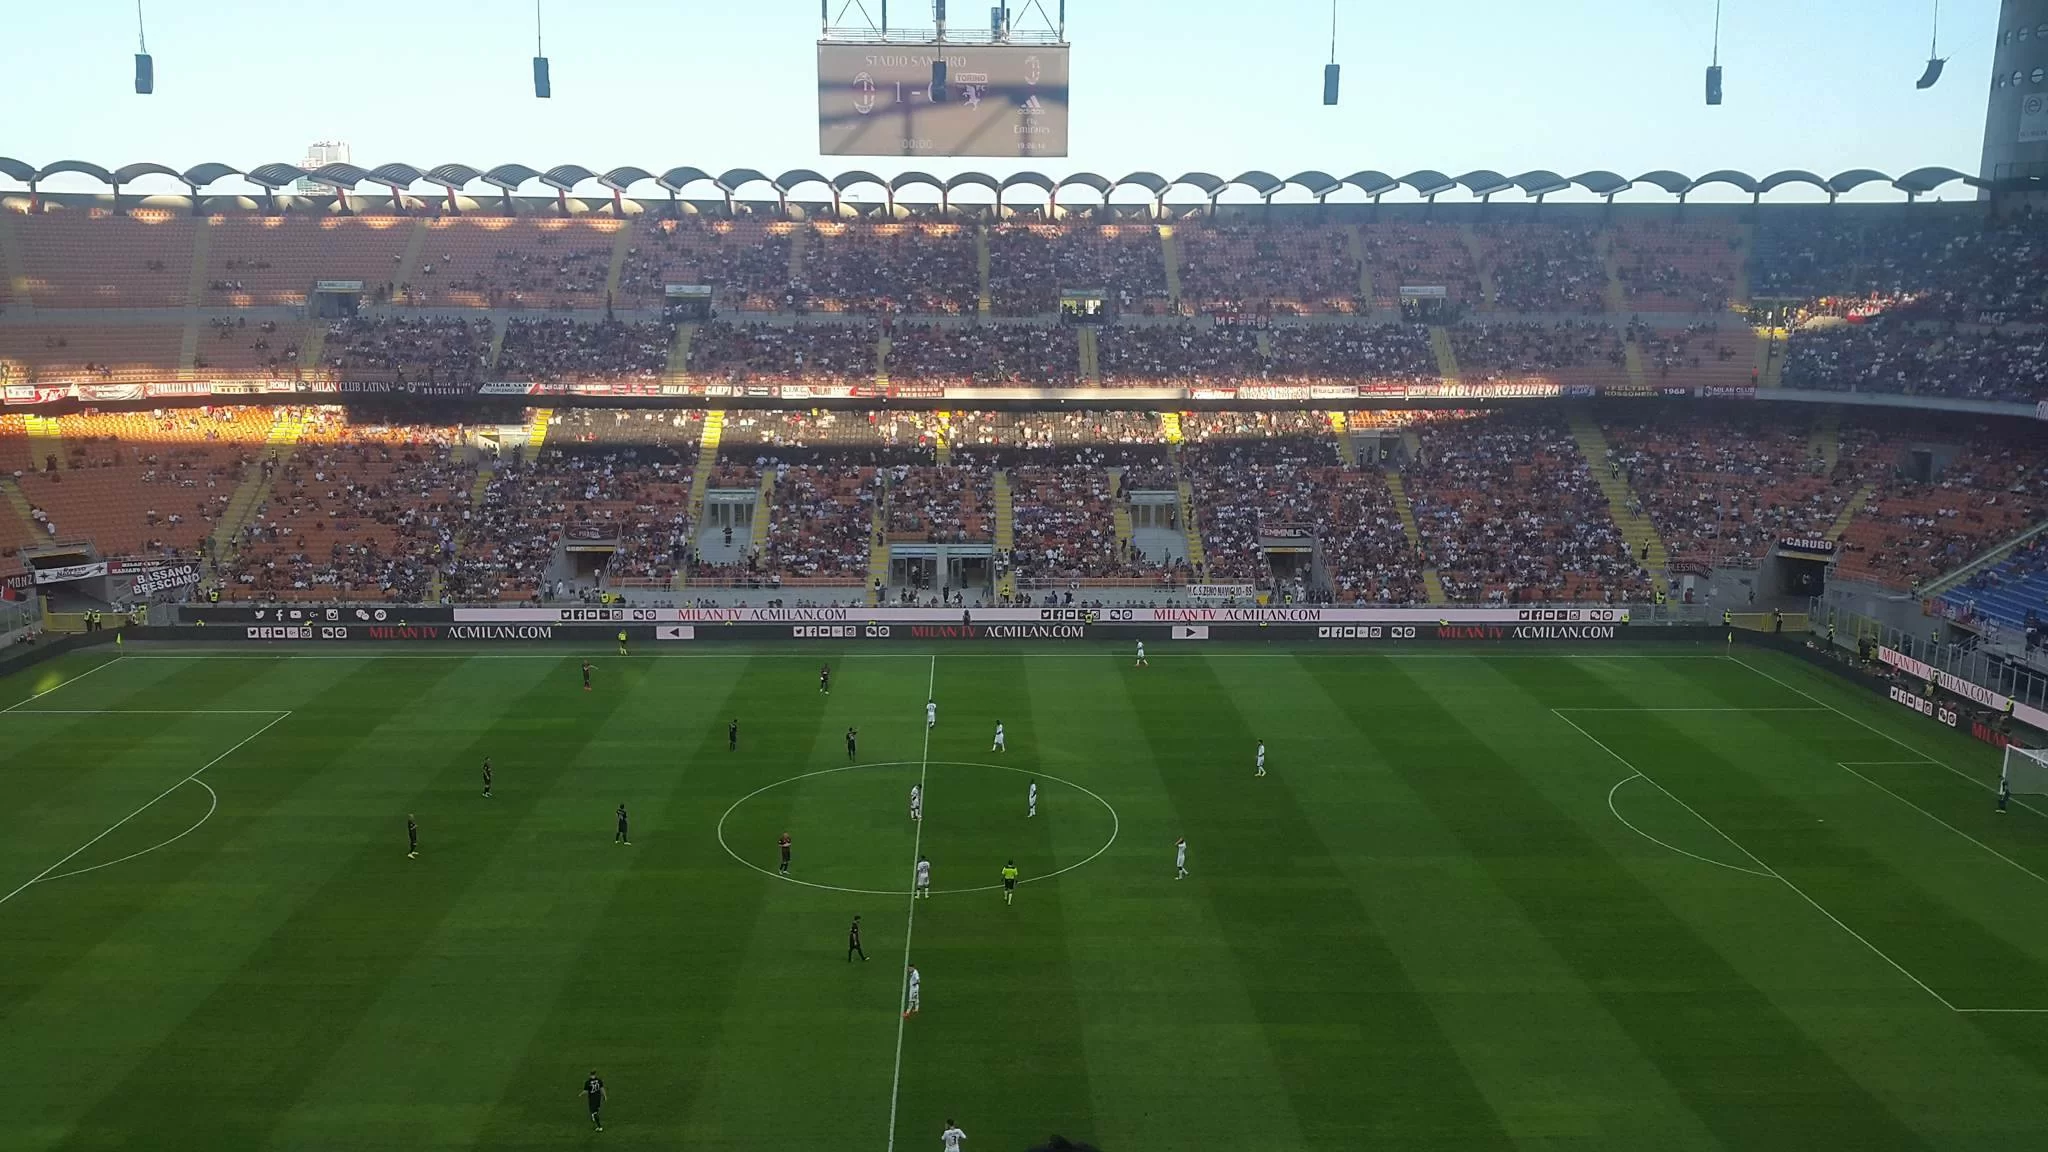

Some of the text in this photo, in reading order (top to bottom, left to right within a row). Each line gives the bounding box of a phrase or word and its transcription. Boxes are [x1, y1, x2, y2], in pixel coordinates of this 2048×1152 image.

[865, 55, 908, 67] STADIO
[895, 80, 904, 103] 1
[311, 382, 391, 392] MILAN CLUB LATINA
[1439, 385, 1482, 396] MAGLIA
[1495, 384, 1560, 396] ROSSONERA
[1663, 387, 1685, 395] 1968
[1786, 537, 1833, 550] CARUGO
[7, 573, 36, 589] MONZ
[136, 565, 192, 585] BASSANO
[133, 573, 200, 595] BRESCIANO
[678, 609, 847, 621] MILAN TV ACMILAN.COM
[1153, 609, 1321, 621] MILAN TV ACMILAN.COM
[368, 626, 552, 639] MILAN TV ACMILAN.COM
[912, 625, 1084, 638] MILAN TV ACMILAN.COM
[1438, 626, 1614, 639] MILAN TV ACMILAN.COM
[1882, 648, 1910, 672] MILAN
